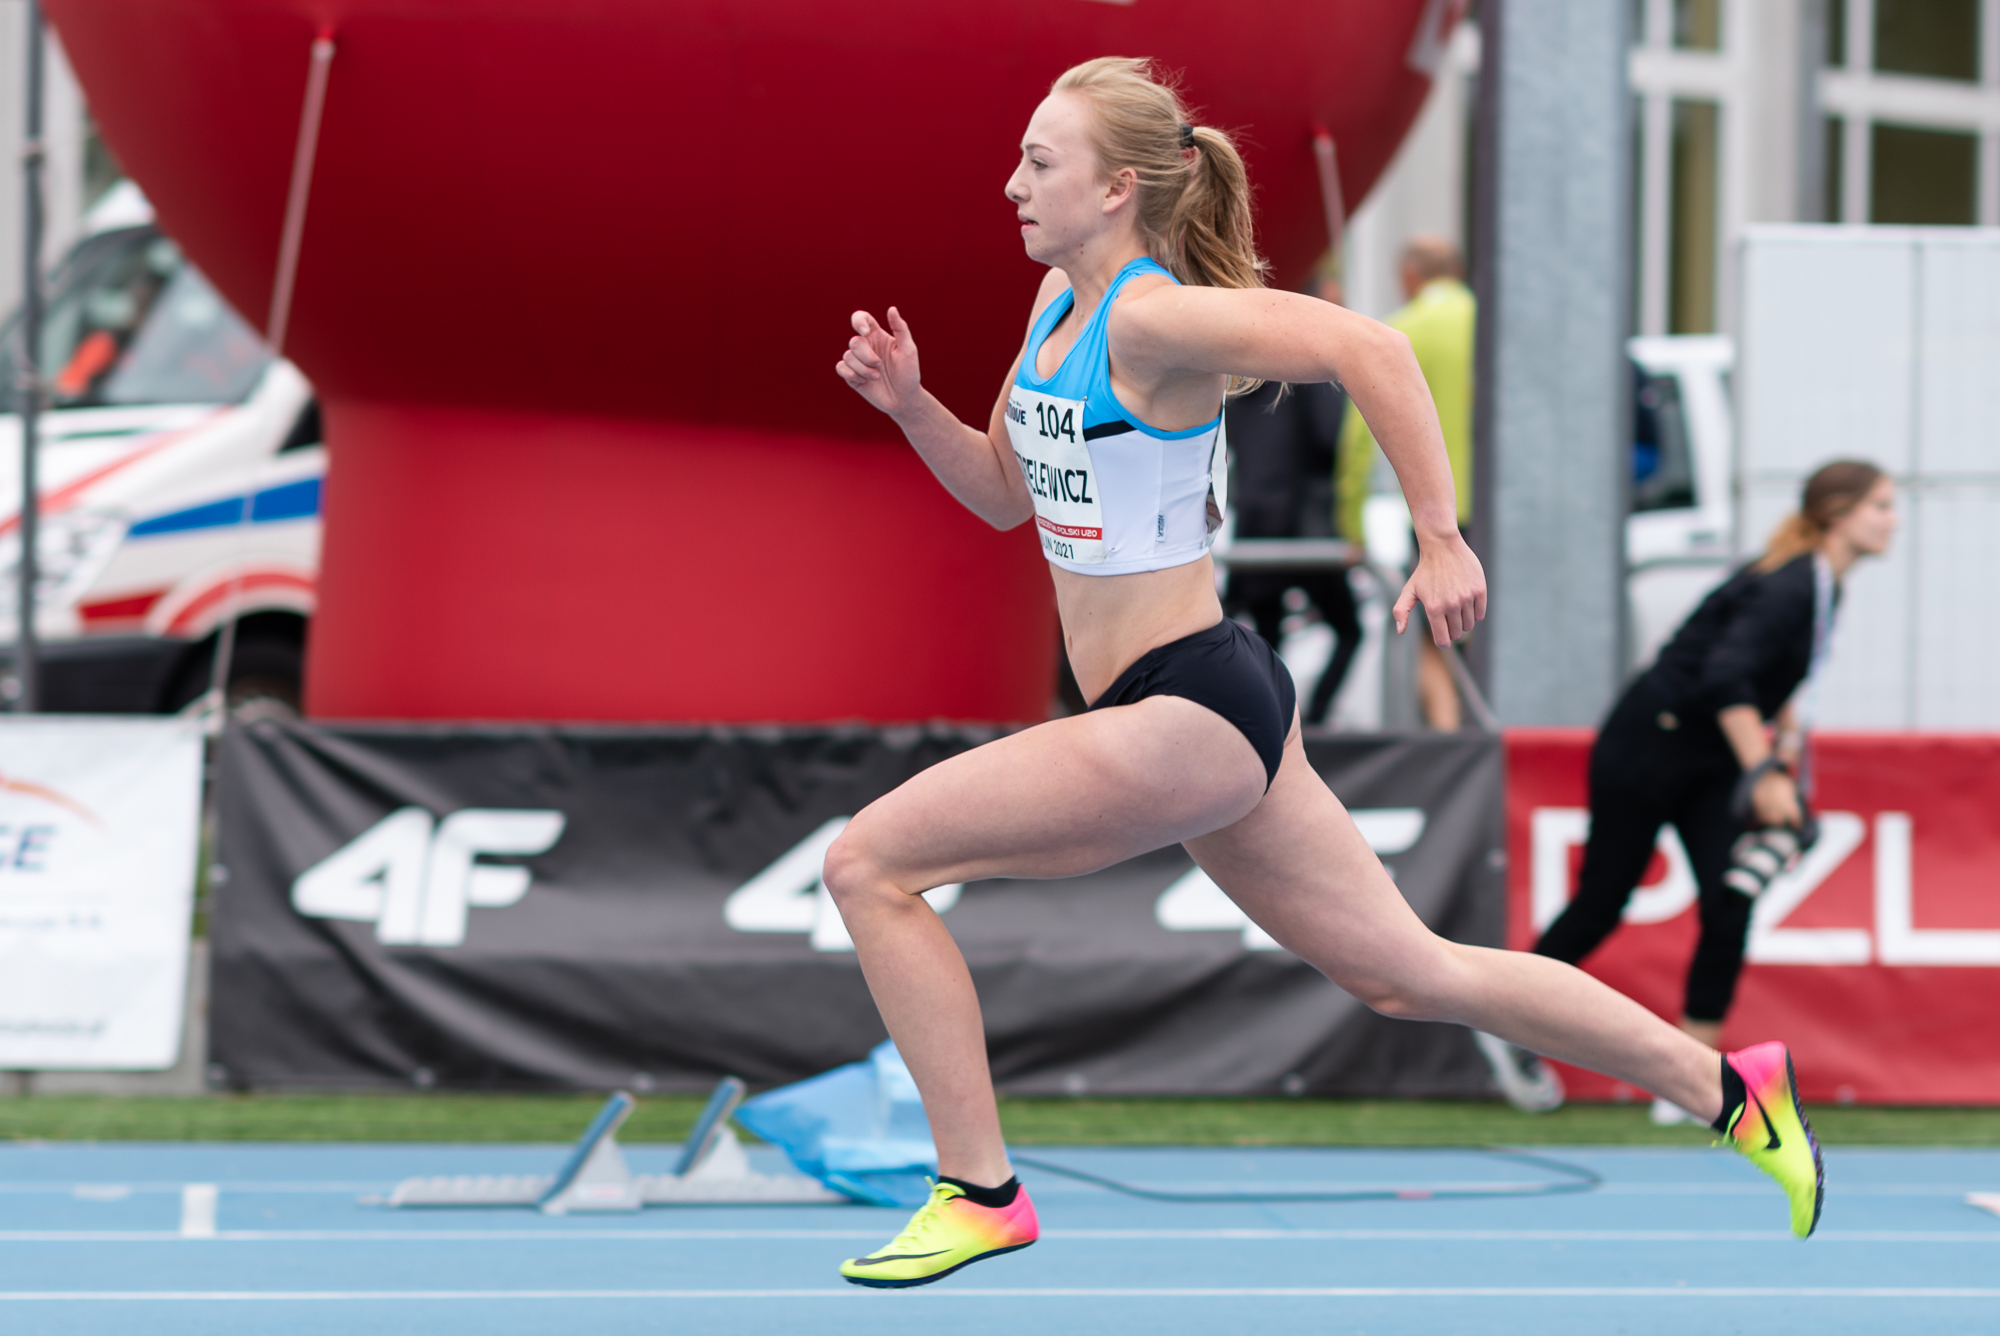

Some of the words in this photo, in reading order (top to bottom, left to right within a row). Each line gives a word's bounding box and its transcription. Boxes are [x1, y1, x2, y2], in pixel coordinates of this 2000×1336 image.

[1036, 401, 1076, 444] 104
[1053, 539, 1075, 560] 2021
[1057, 525, 1080, 537] POLSKI
[1080, 528, 1098, 538] U20
[292, 806, 566, 946] 4F
[724, 814, 965, 953] 4
